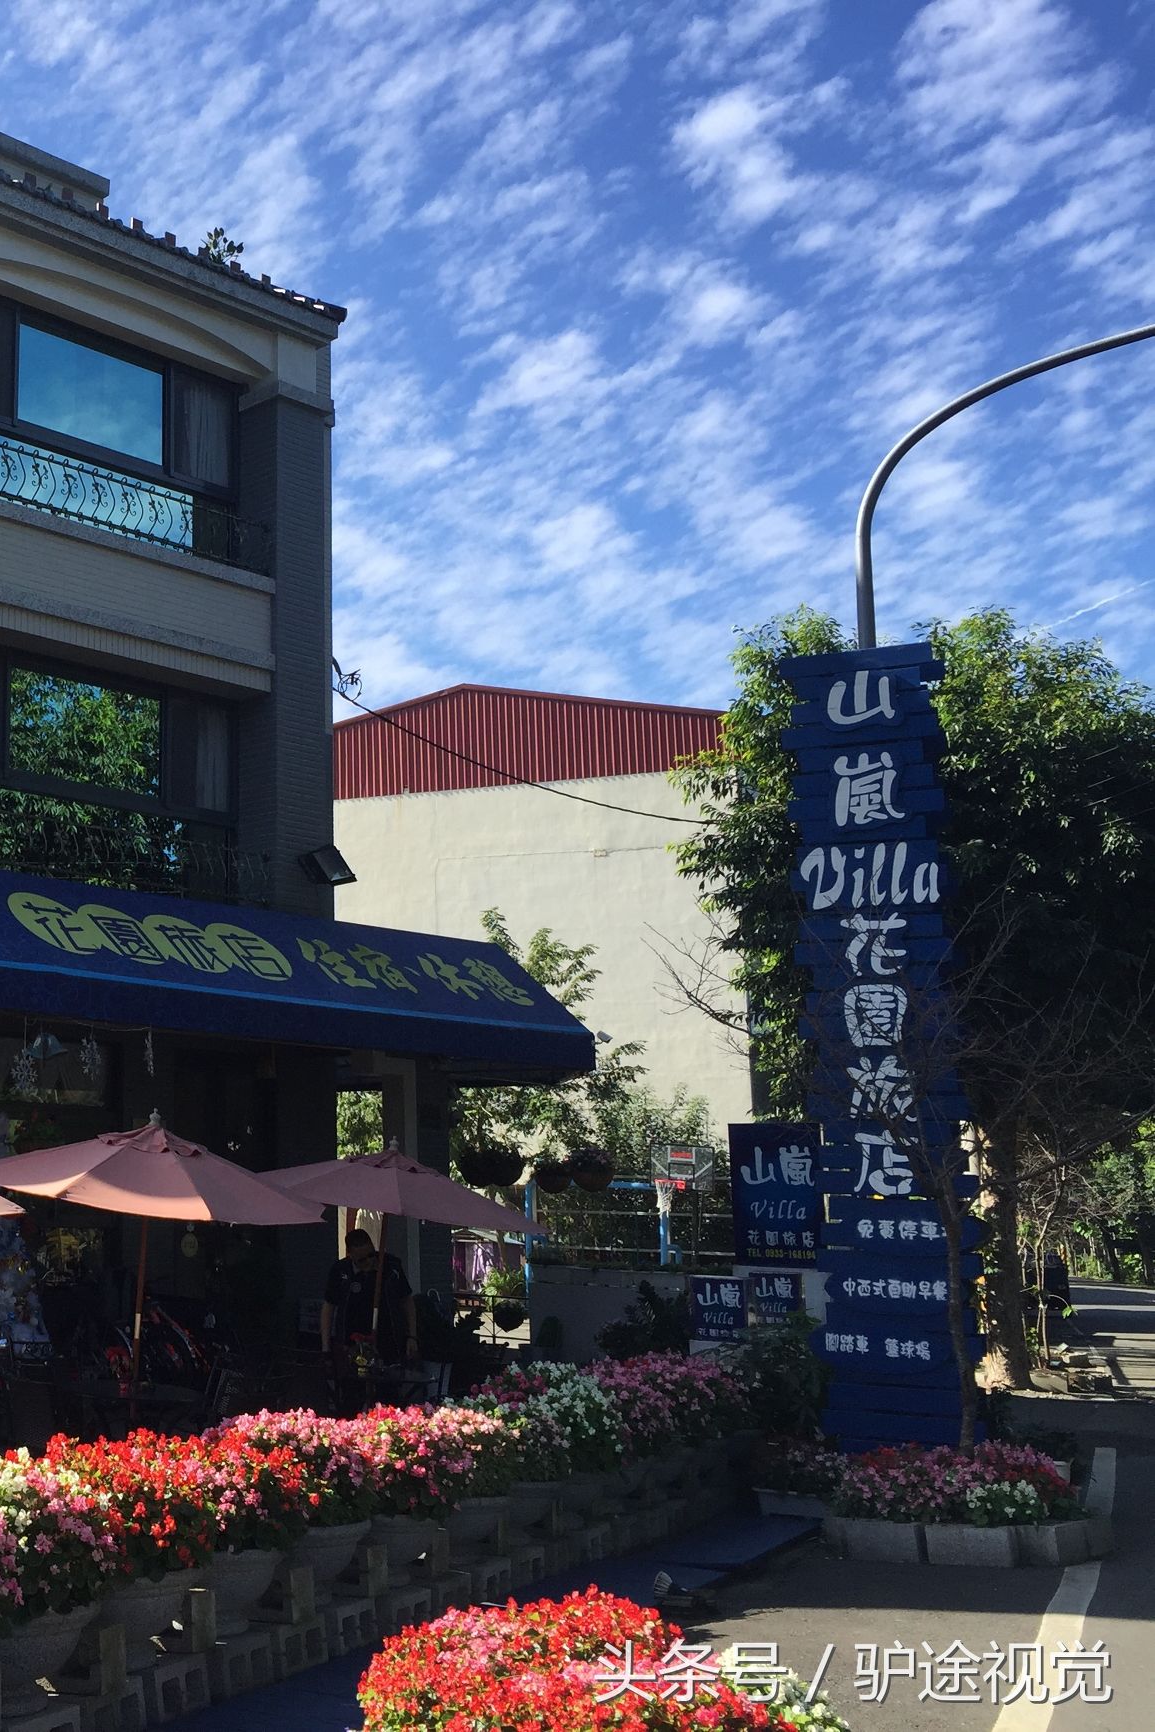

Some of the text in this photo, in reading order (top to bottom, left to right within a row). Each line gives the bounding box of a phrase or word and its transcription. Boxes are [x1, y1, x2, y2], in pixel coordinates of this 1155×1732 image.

[800, 842, 940, 910] Villa
[14, 894, 290, 981] 花園旅店
[741, 1145, 814, 1187] 山嵐
[750, 1200, 807, 1221] Villa
[747, 1229, 815, 1249] 花園旅店
[696, 1283, 741, 1308] 山嵐
[755, 1277, 793, 1298] 山嵐
[703, 1311, 734, 1325] Villa
